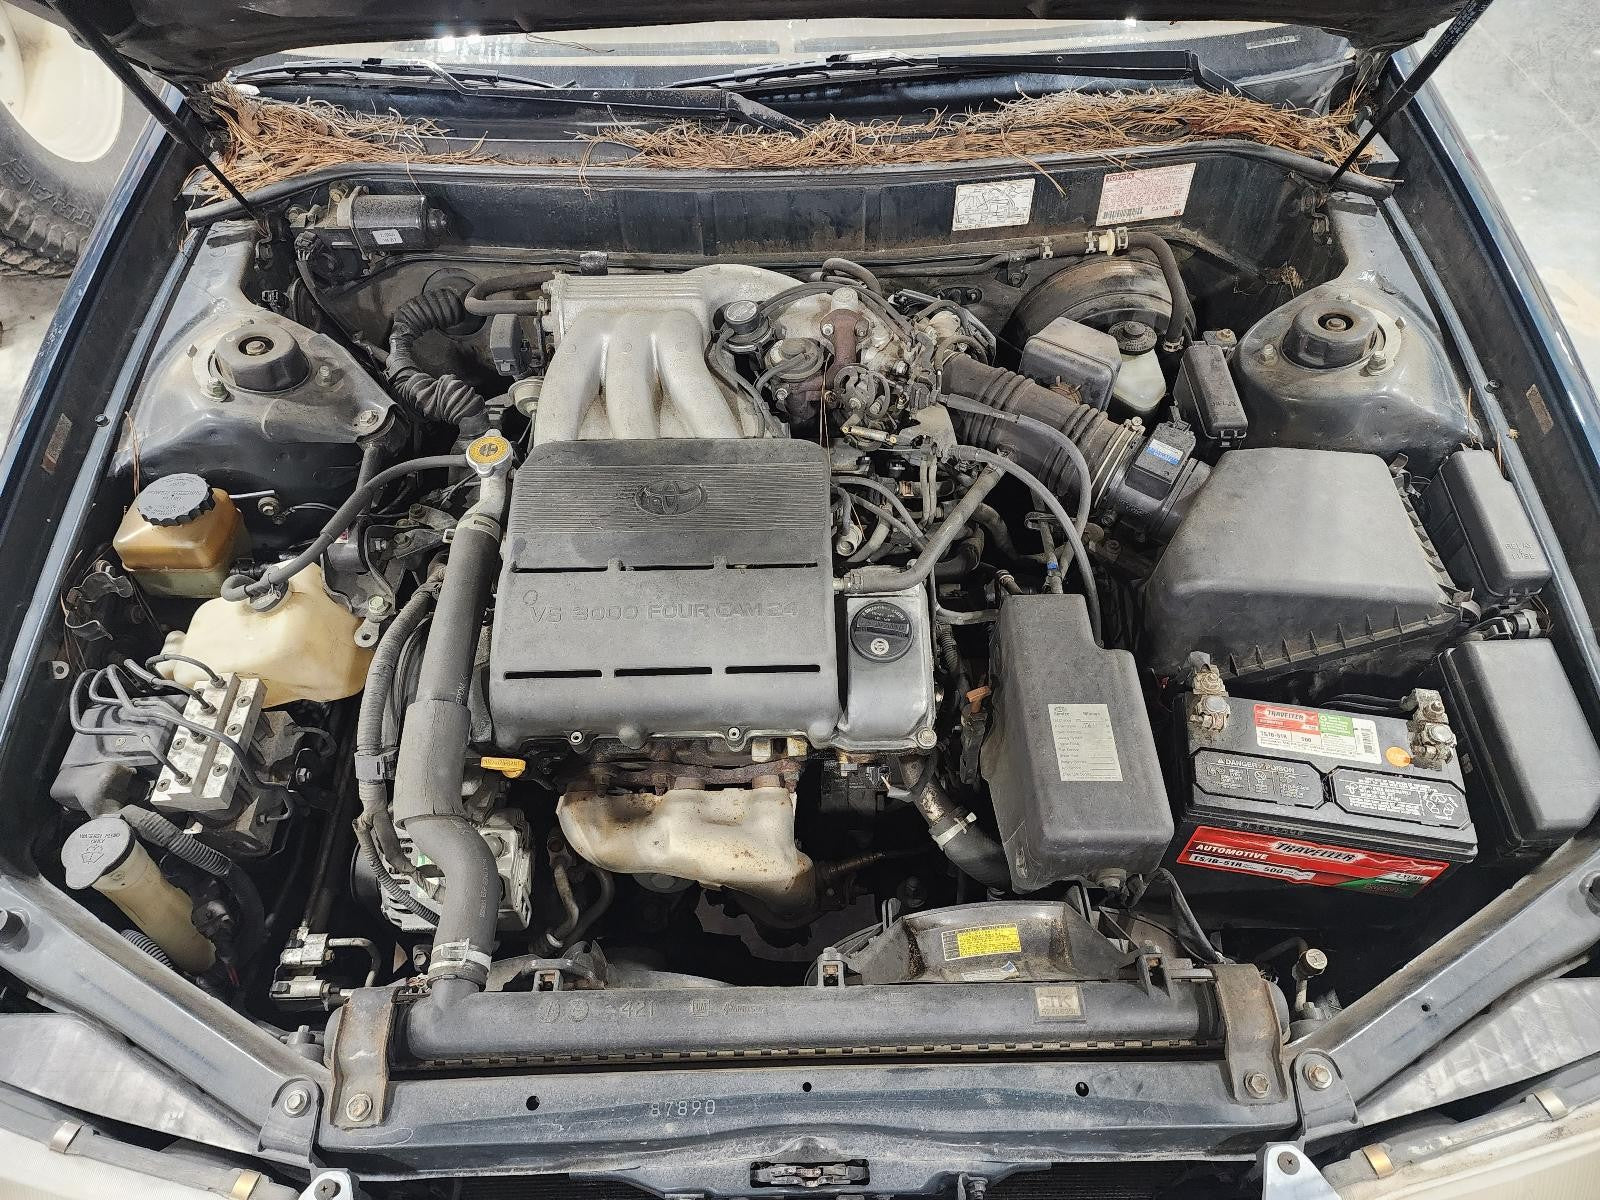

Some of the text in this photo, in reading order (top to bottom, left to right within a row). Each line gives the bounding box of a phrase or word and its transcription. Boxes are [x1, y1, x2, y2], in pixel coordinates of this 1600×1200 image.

[1106, 173, 1135, 181] TOYOTA
[571, 606, 639, 621] 3000
[647, 602, 710, 619] FOUR
[714, 601, 762, 618] CAM
[1195, 844, 1270, 861] AUTOMOTIVE
[1274, 842, 1357, 863] TRAVELLER
[651, 1100, 716, 1117] 87890
